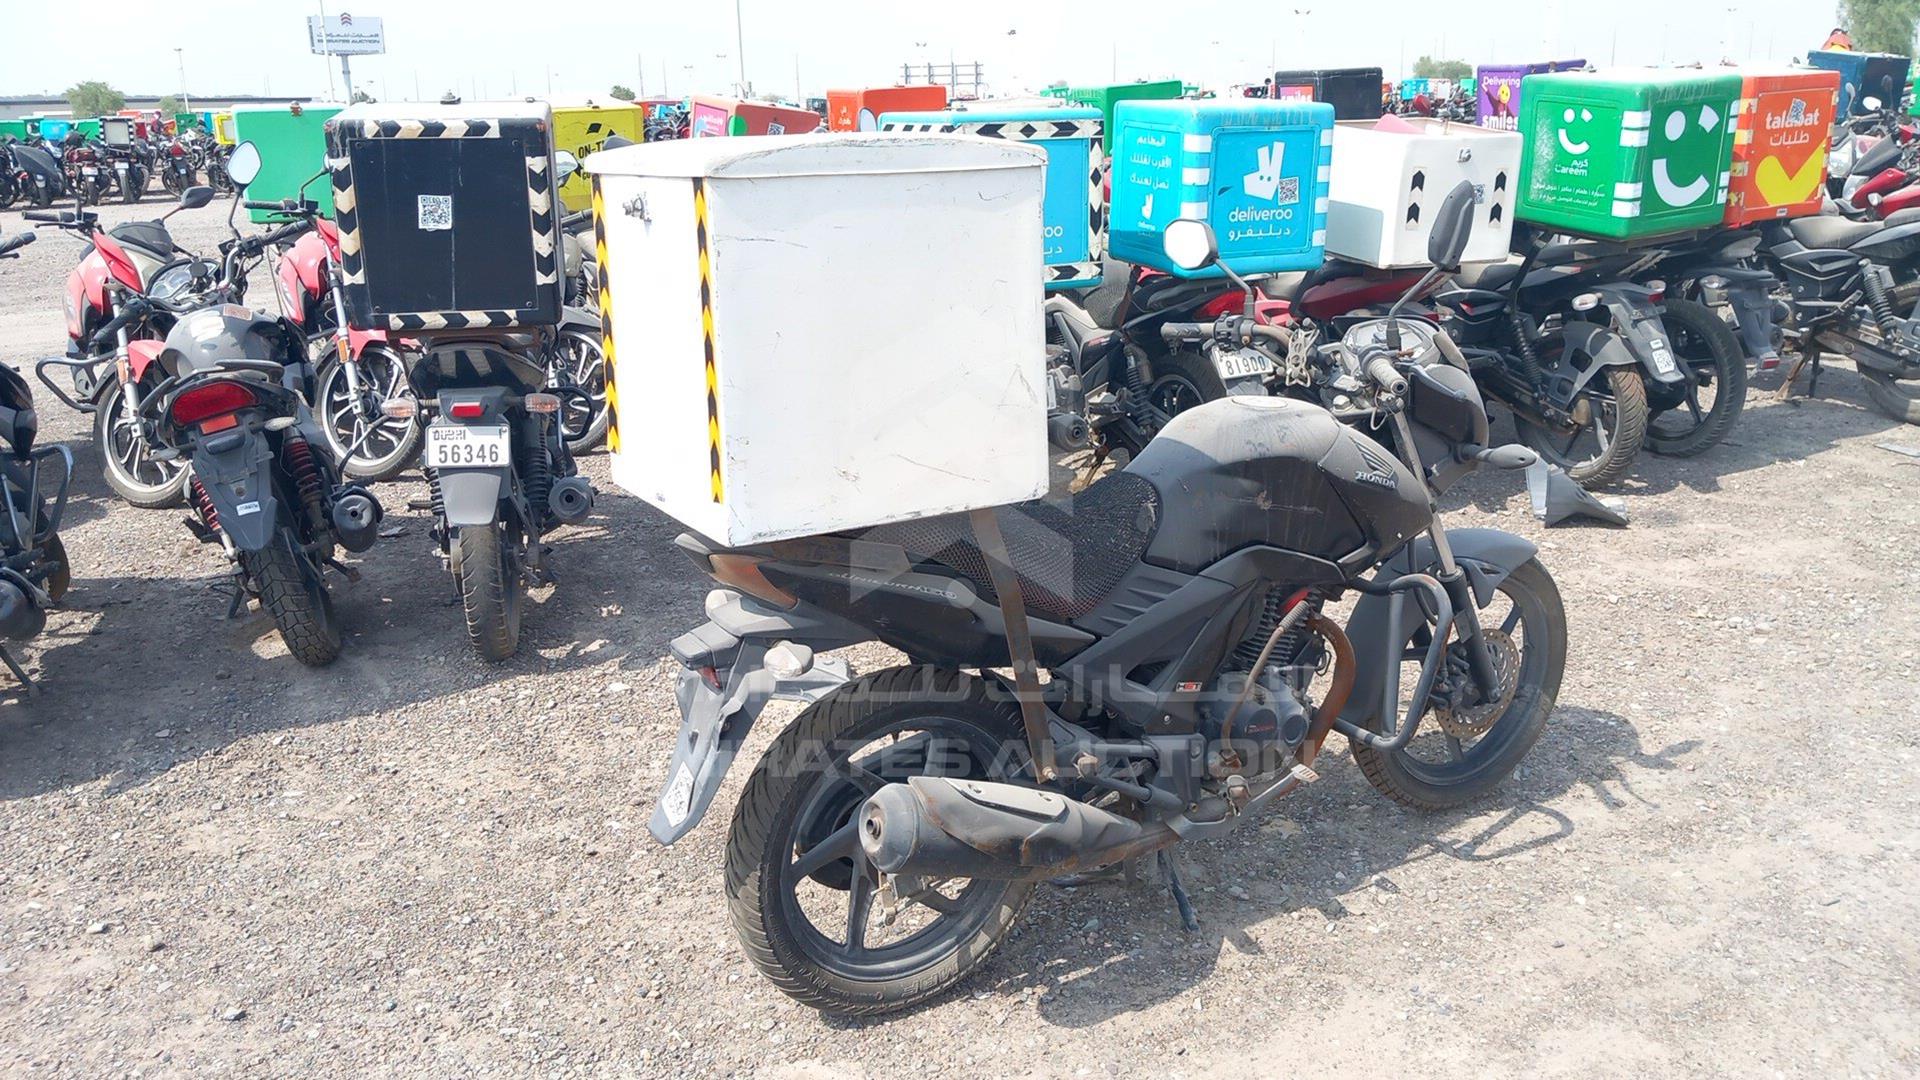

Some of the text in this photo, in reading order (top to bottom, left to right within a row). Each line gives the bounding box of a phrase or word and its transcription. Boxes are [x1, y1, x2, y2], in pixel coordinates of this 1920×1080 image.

[1770, 130, 1810, 149] طلبات
[1228, 205, 1293, 222] deliveroo
[1228, 224, 1290, 241] ديليفرو
[1225, 355, 1266, 375] 81900
[439, 443, 499, 464] 56346
[1355, 470, 1396, 488] HONDA
